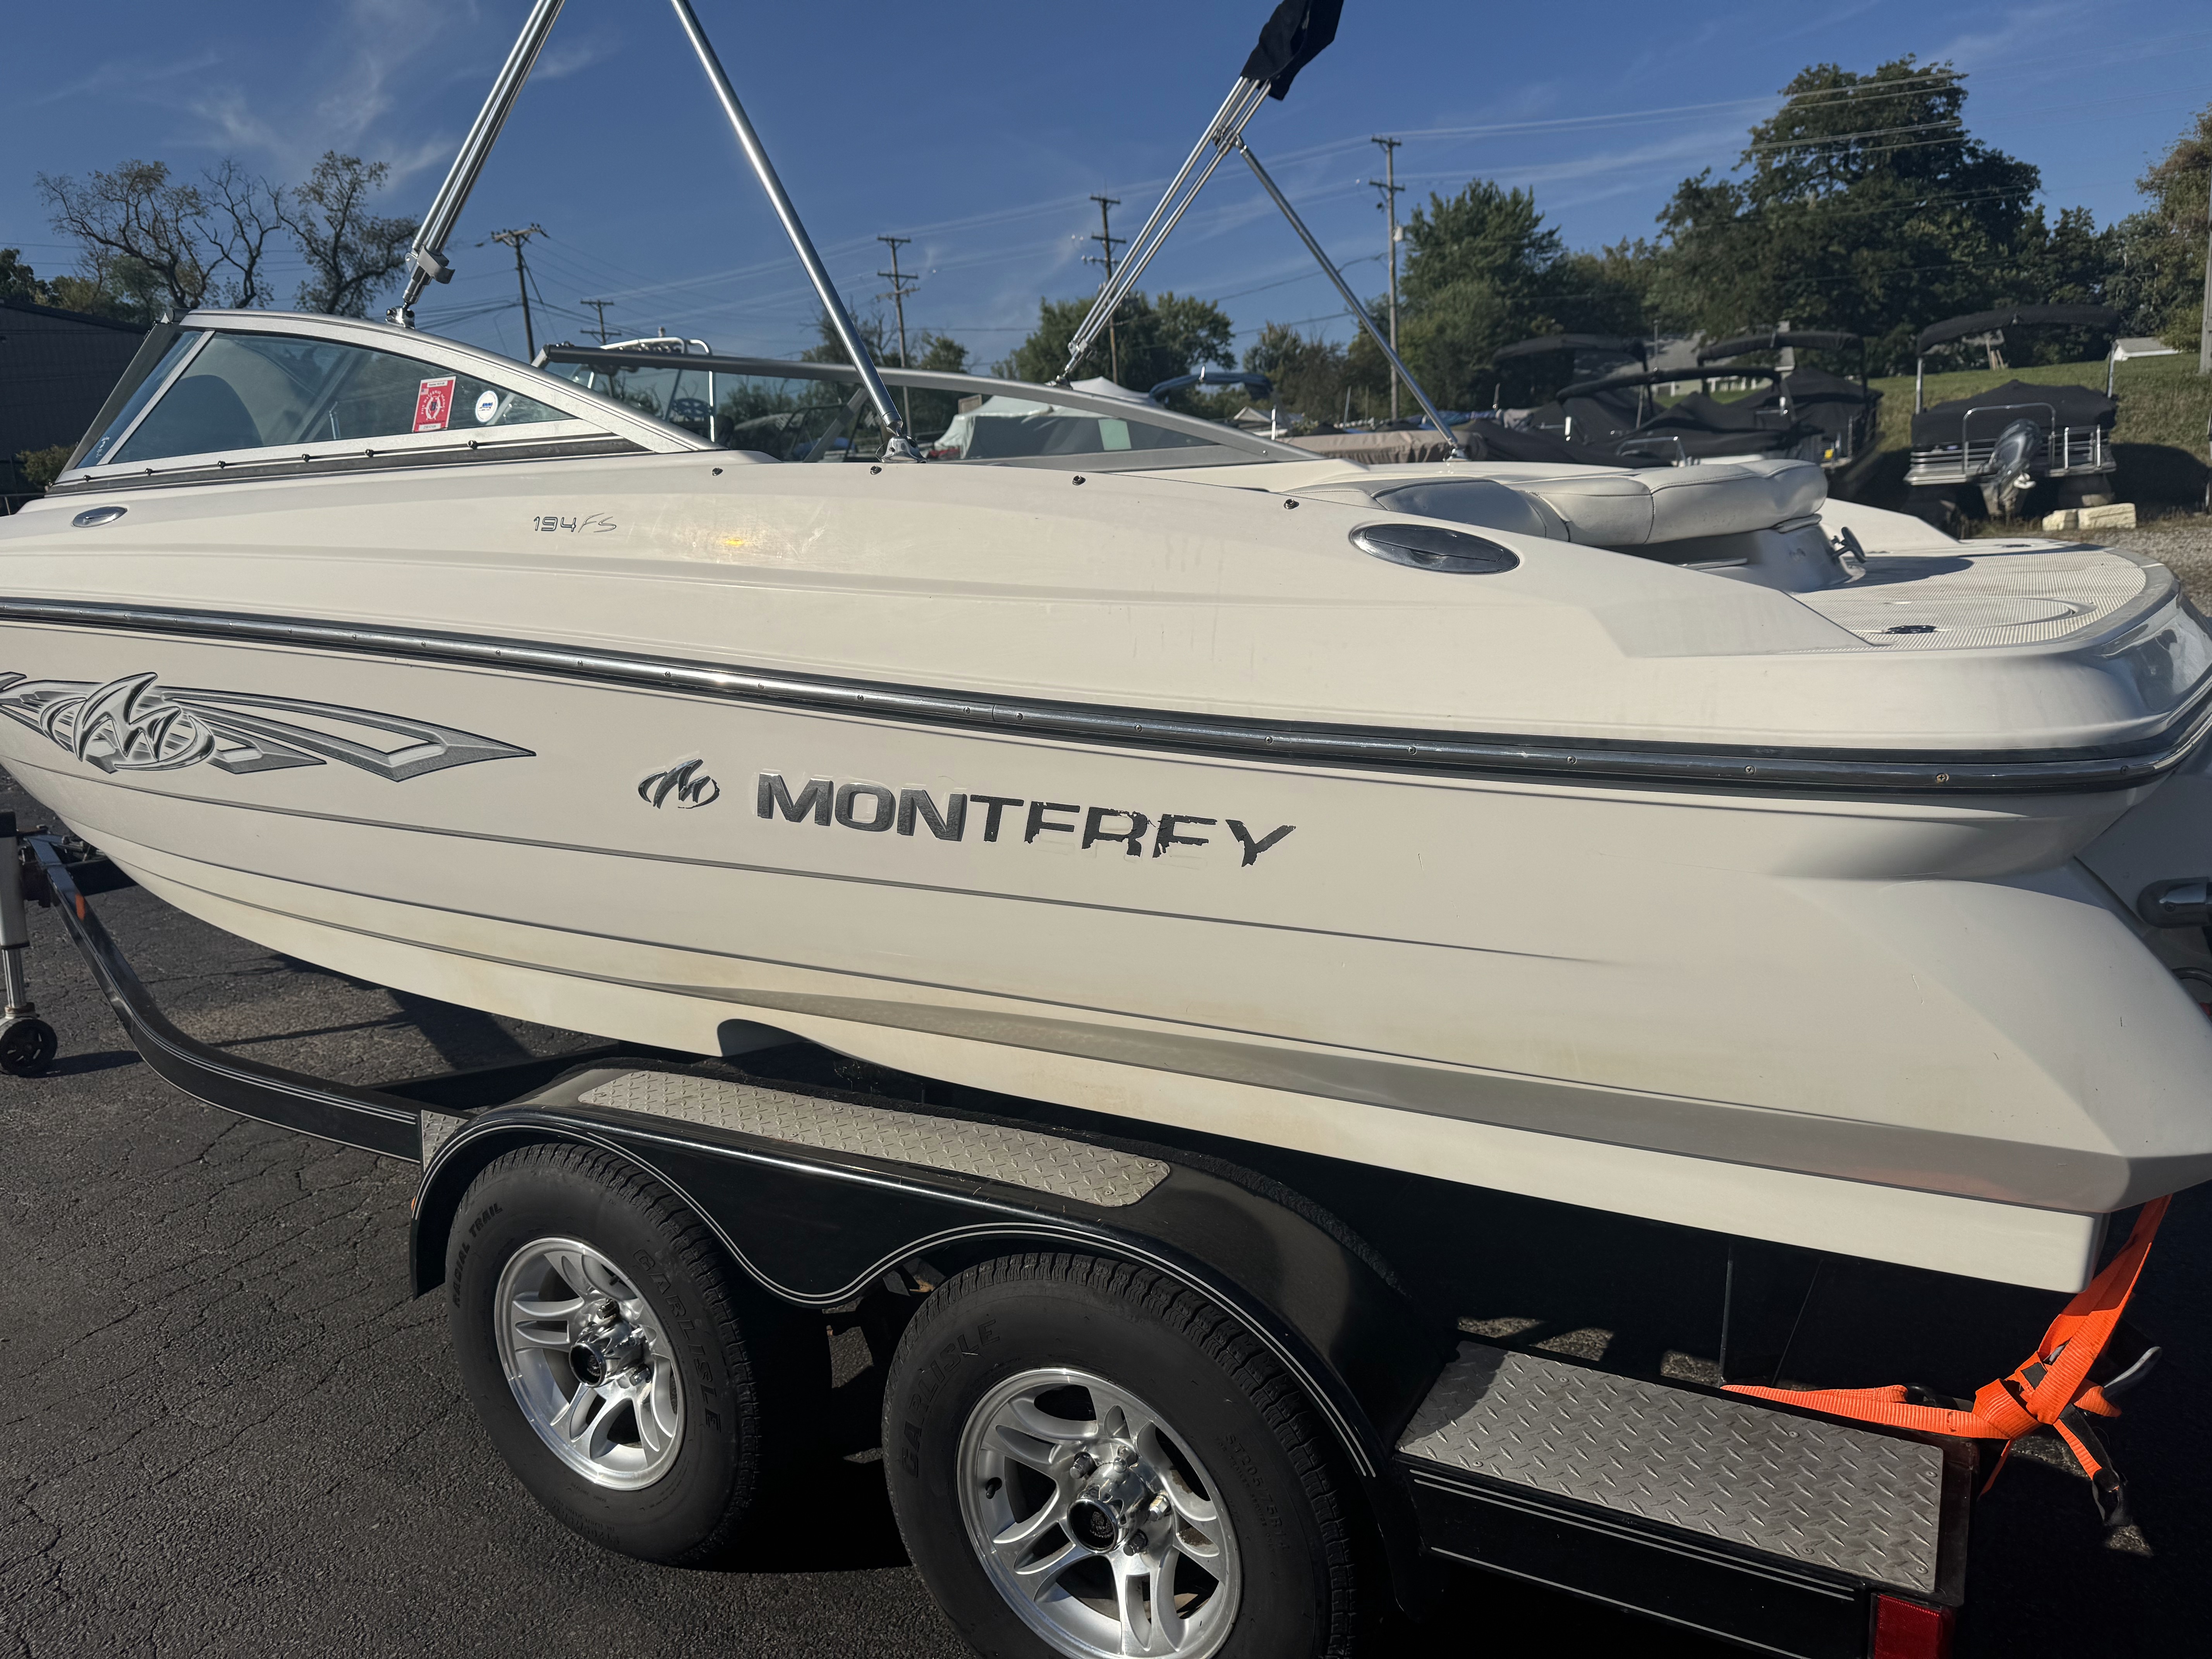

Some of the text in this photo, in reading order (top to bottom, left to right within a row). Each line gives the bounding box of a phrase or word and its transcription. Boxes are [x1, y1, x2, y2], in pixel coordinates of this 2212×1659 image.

[756, 771, 1297, 867] MONTEREY
[452, 1202, 504, 1309] RADIAL TRAIL
